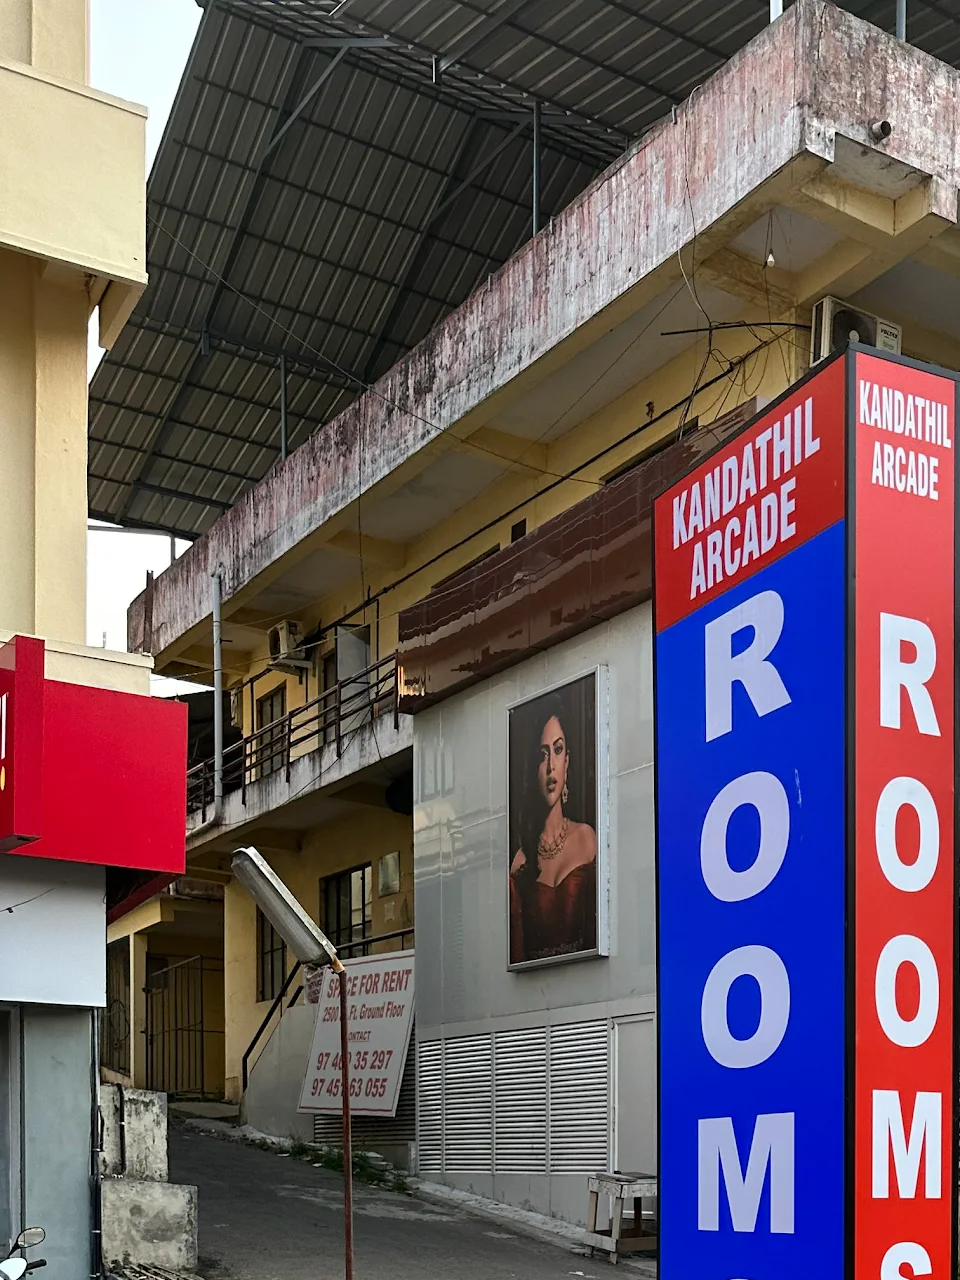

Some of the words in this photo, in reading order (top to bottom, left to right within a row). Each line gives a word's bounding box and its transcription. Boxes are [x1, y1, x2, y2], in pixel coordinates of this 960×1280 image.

[860, 380, 952, 448] KANDATHIL
[673, 397, 820, 549] KANDATHIL
[871, 446, 939, 500] ARCADE
[690, 476, 797, 600] ARCADE
[359, 972, 381, 996] FOR
[381, 969, 412, 993] RENT
[360, 1001, 384, 1020] Ground
[385, 1001, 405, 1018] Floor
[347, 1031, 371, 1041] ONTACT
[316, 1052, 331, 1070] 97
[354, 1051, 369, 1070] 35
[370, 1050, 394, 1070] 297
[311, 1078, 326, 1096] 97
[349, 1078, 363, 1097] 63
[365, 1078, 388, 1097] 055
